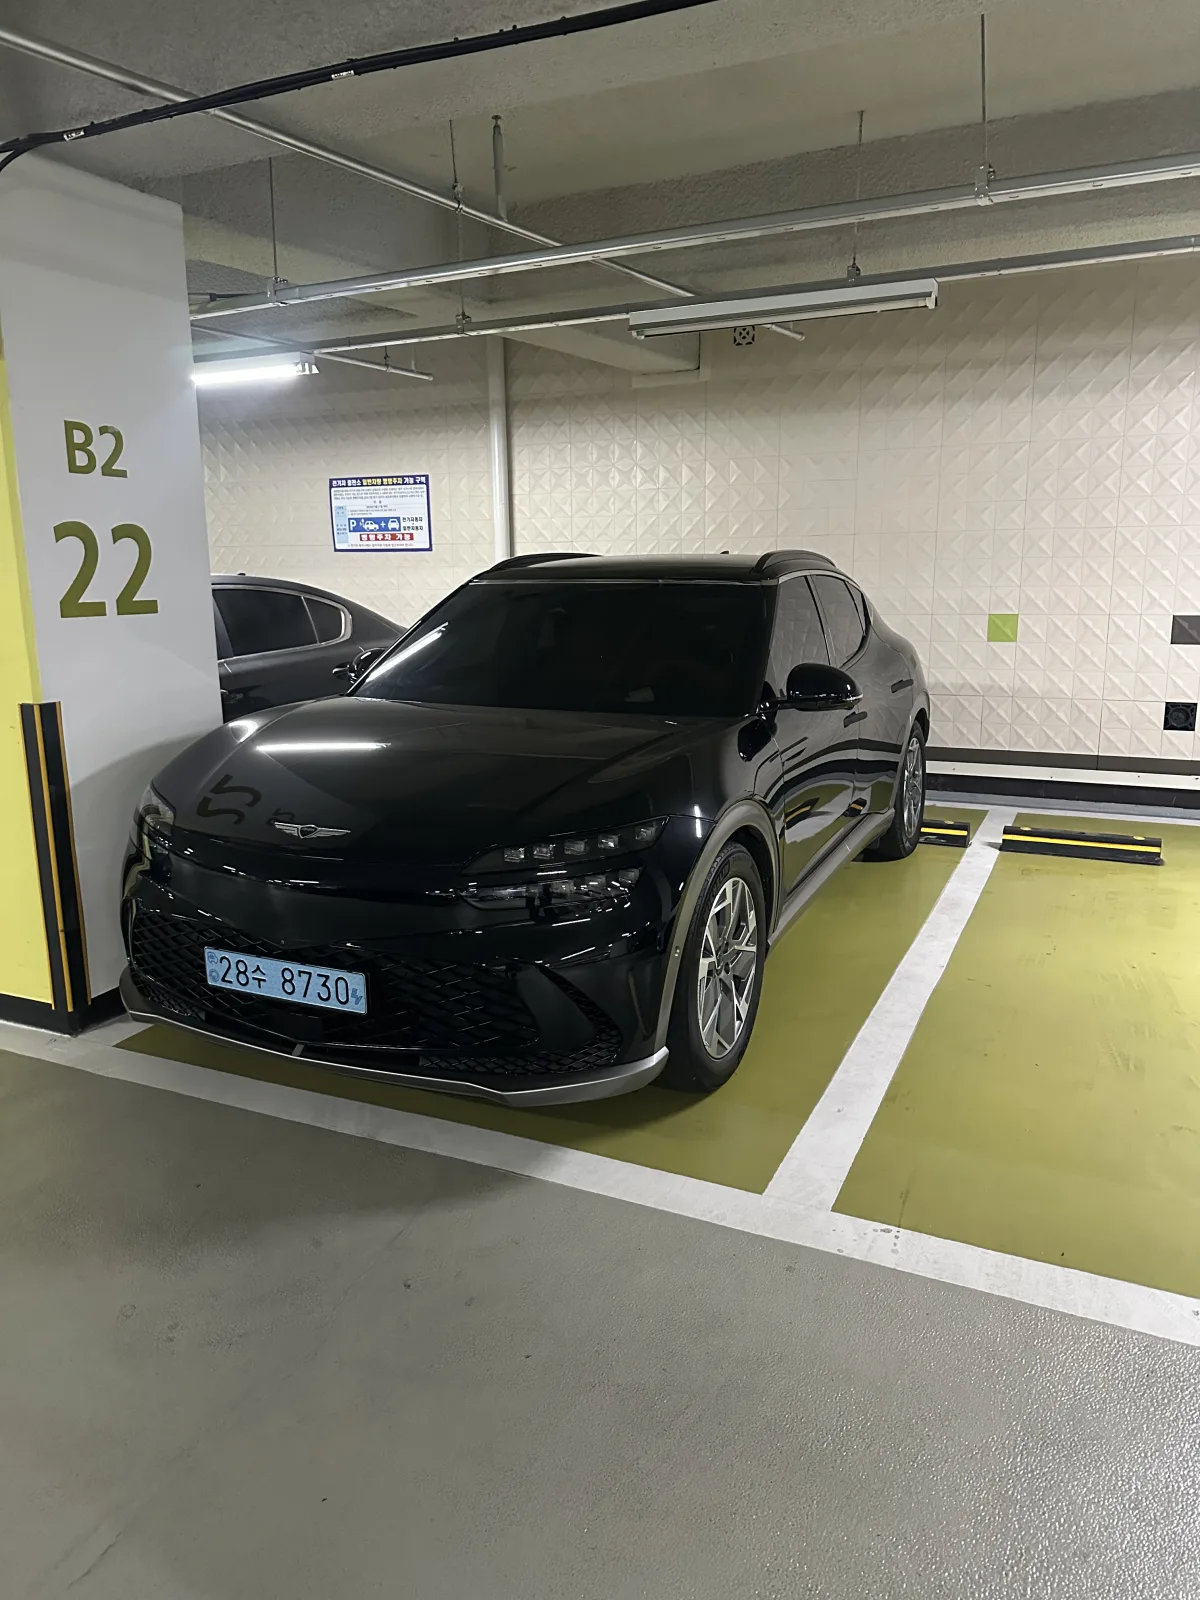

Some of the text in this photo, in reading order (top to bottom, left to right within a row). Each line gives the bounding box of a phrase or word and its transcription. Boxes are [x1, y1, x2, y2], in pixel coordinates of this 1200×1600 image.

[63, 419, 128, 478] B2
[349, 519, 357, 531] P
[53, 520, 159, 619] 22
[219, 955, 350, 1005] 28수 8730
